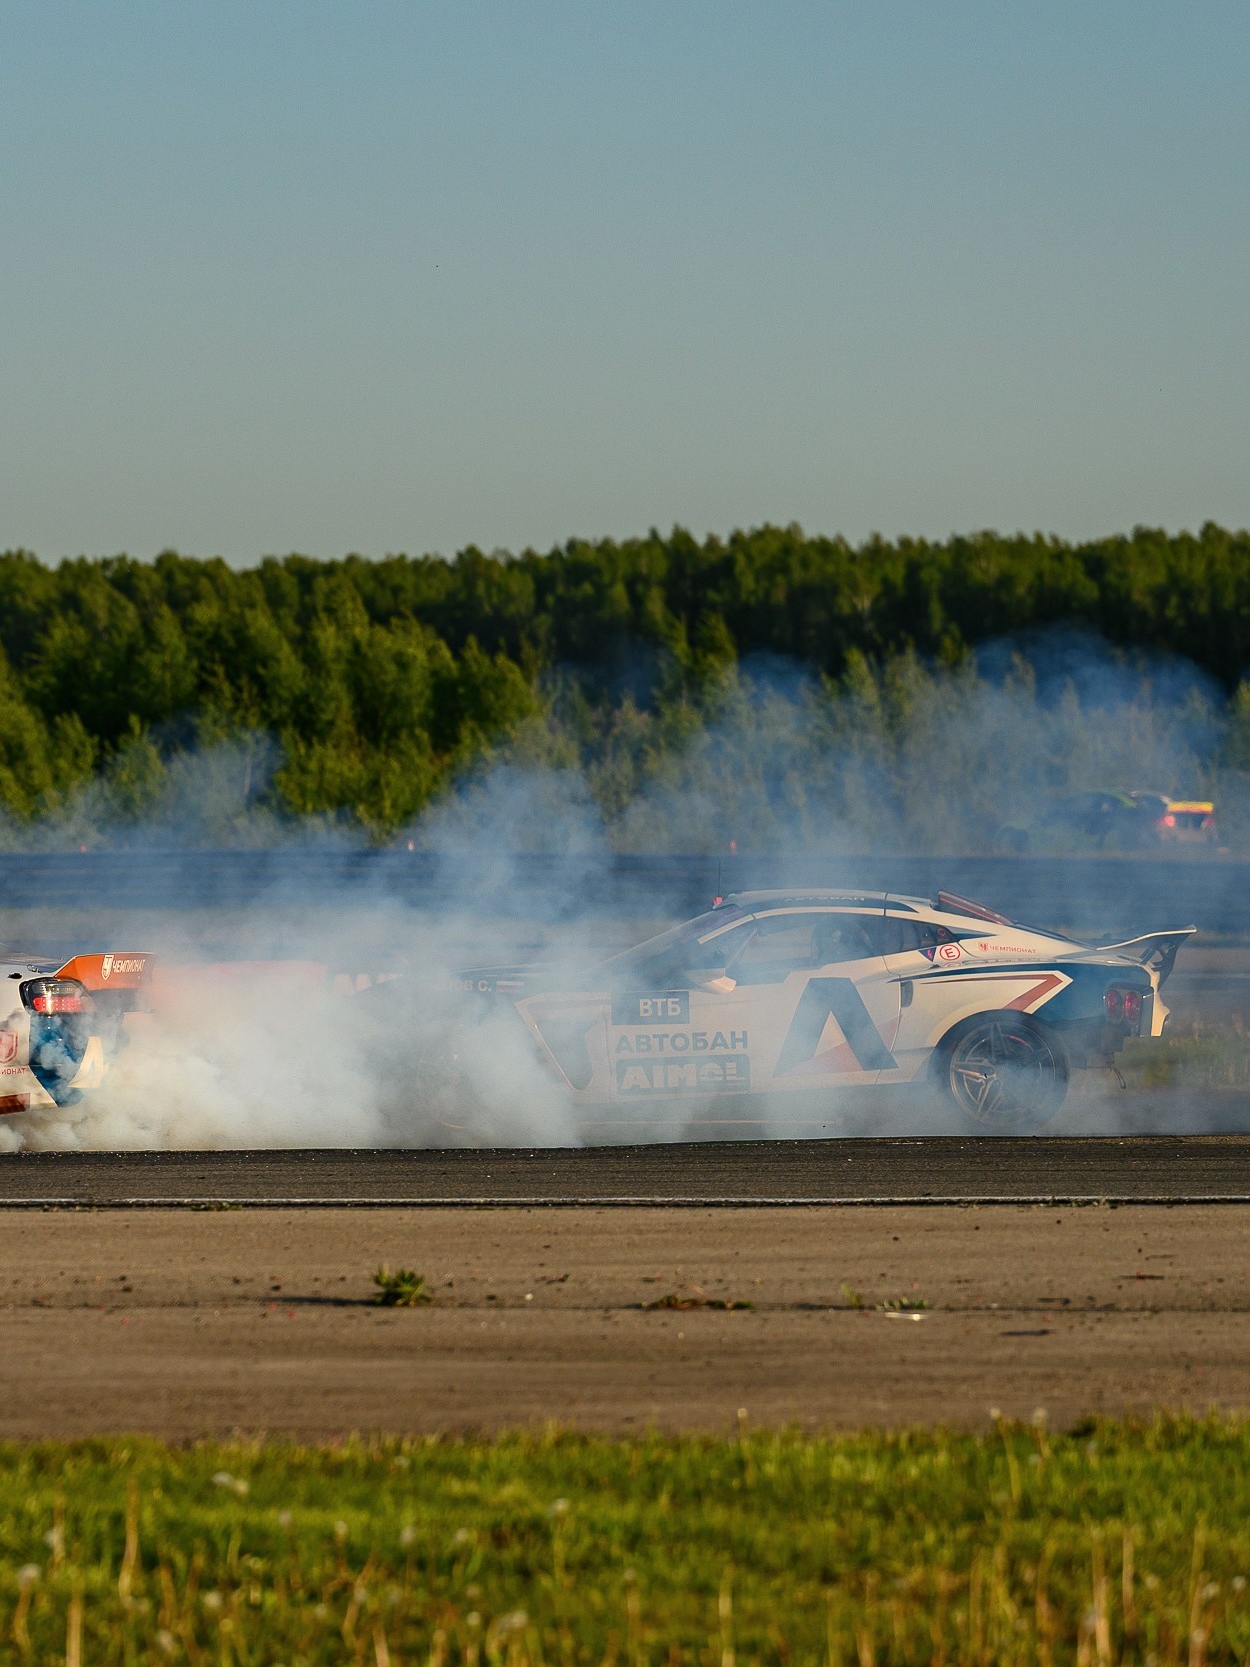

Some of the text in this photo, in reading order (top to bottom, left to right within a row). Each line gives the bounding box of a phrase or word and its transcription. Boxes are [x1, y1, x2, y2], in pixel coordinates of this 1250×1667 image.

[990, 945, 1036, 953] ЧЕМПИОНАТ
[639, 998, 681, 1017] ВТБ
[615, 1030, 747, 1053] АВТОБАН
